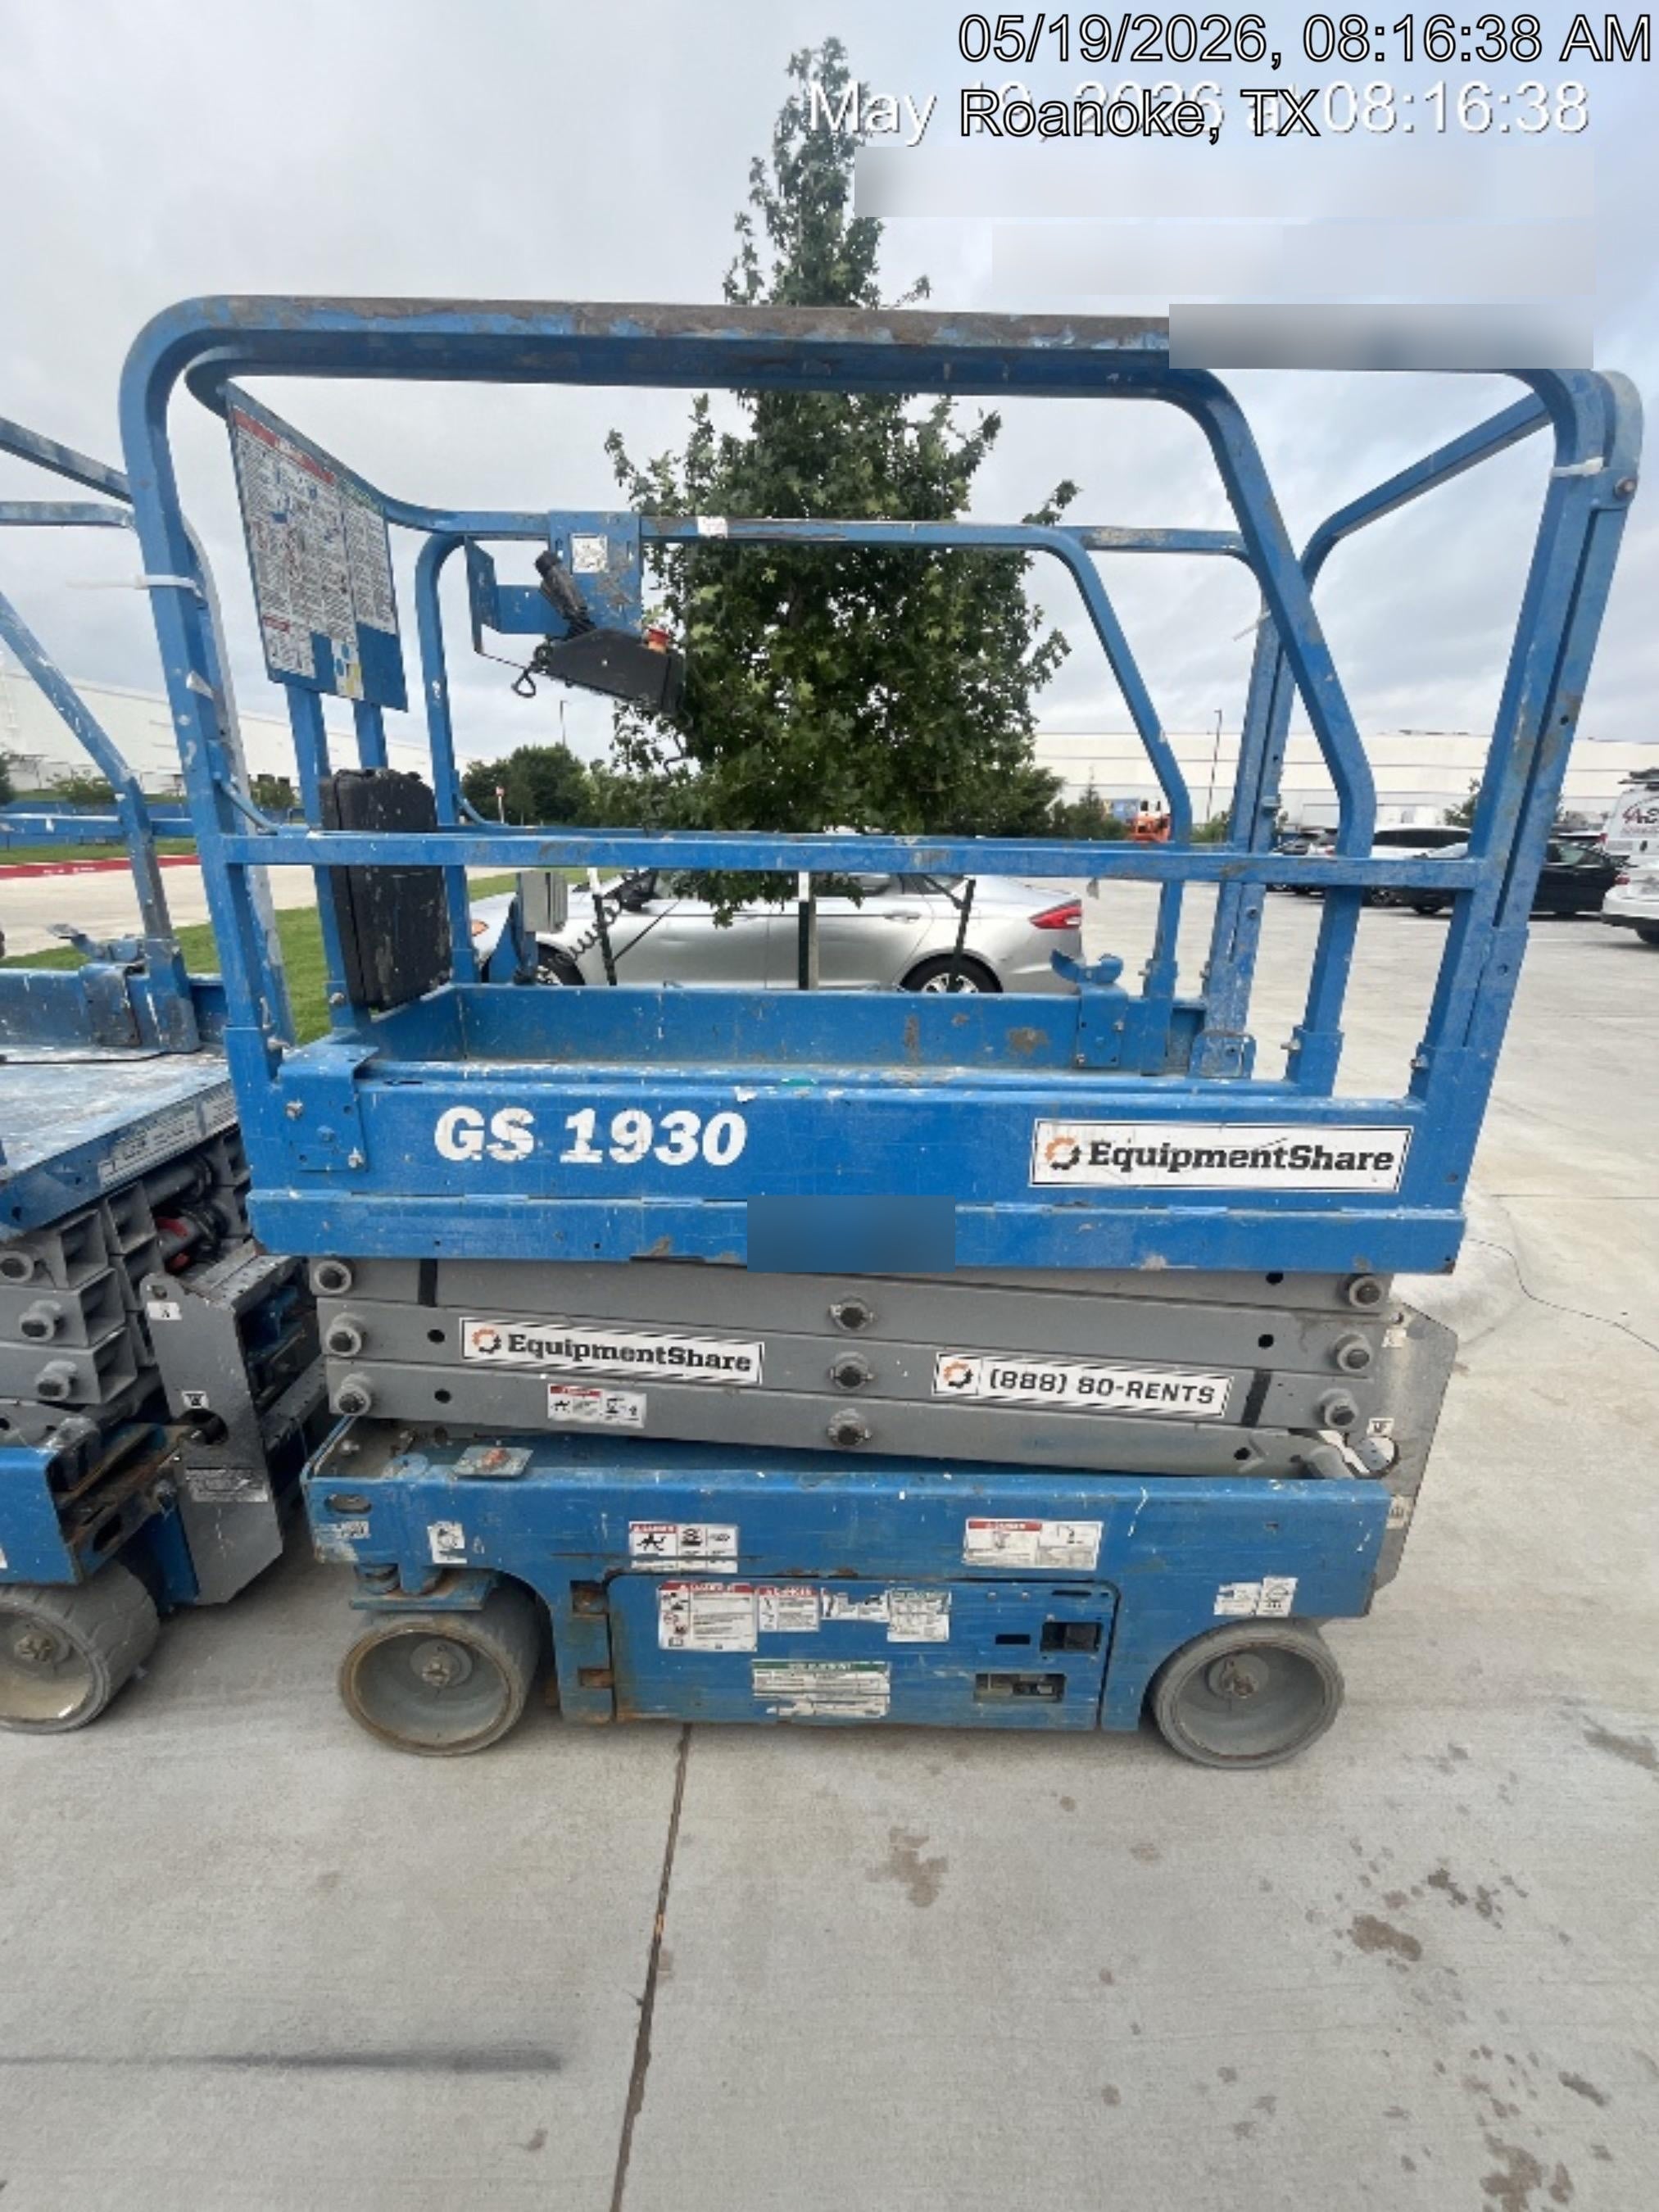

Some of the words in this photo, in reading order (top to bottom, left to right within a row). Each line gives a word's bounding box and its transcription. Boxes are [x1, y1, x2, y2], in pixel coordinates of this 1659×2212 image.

[434, 1106, 535, 1162] GS
[560, 1108, 747, 1166] 1930
[1088, 1140, 1394, 1173] EquipmentShare
[508, 1333, 751, 1372] EquipmentShare
[990, 1368, 1067, 1394] (888)
[1077, 1376, 1215, 1405] 80-RENTS
